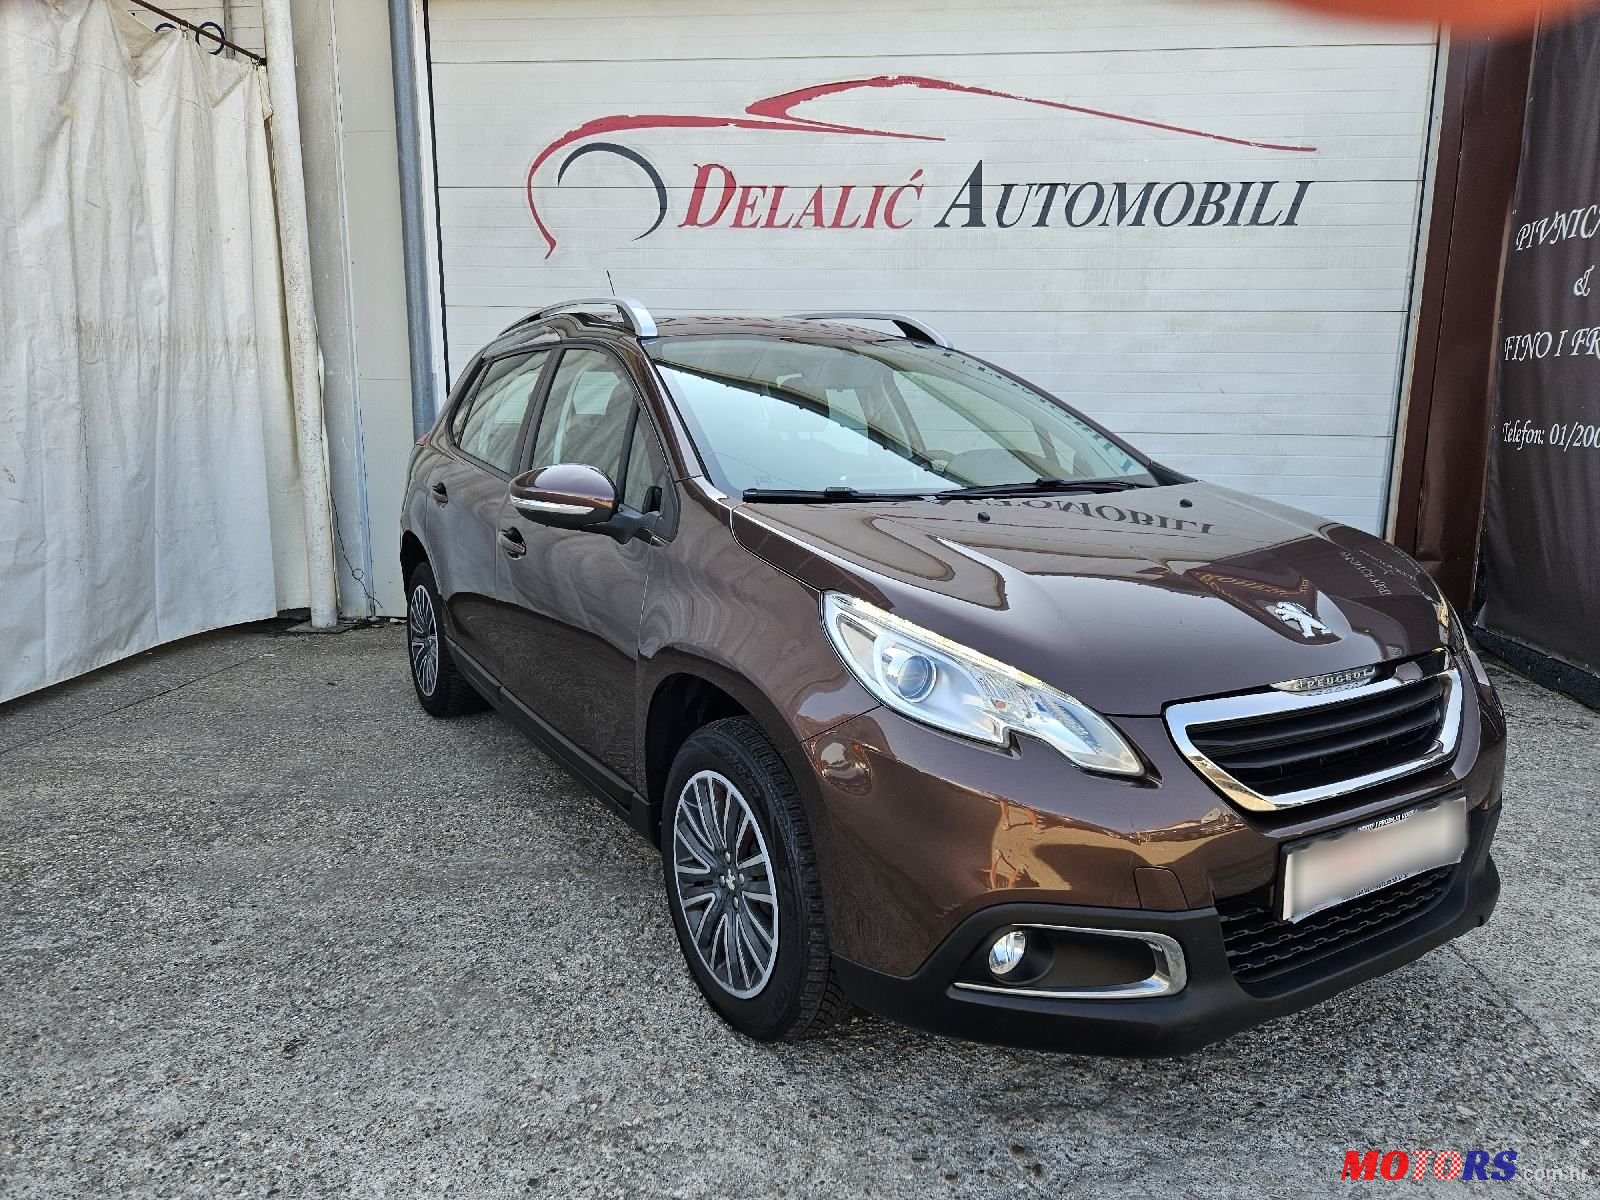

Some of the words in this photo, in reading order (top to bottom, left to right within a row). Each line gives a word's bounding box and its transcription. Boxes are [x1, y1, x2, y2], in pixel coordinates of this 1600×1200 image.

[677, 163, 924, 229] DELALIĆ
[934, 159, 1315, 228] AUTOMOBILI
[1516, 204, 1600, 251] PIVNIC
[1573, 265, 1595, 297] &
[1504, 331, 1553, 362] FINO
[1554, 329, 1569, 357] I
[1502, 419, 1546, 450] Telefon:
[1307, 668, 1371, 689] PEUGEOT
